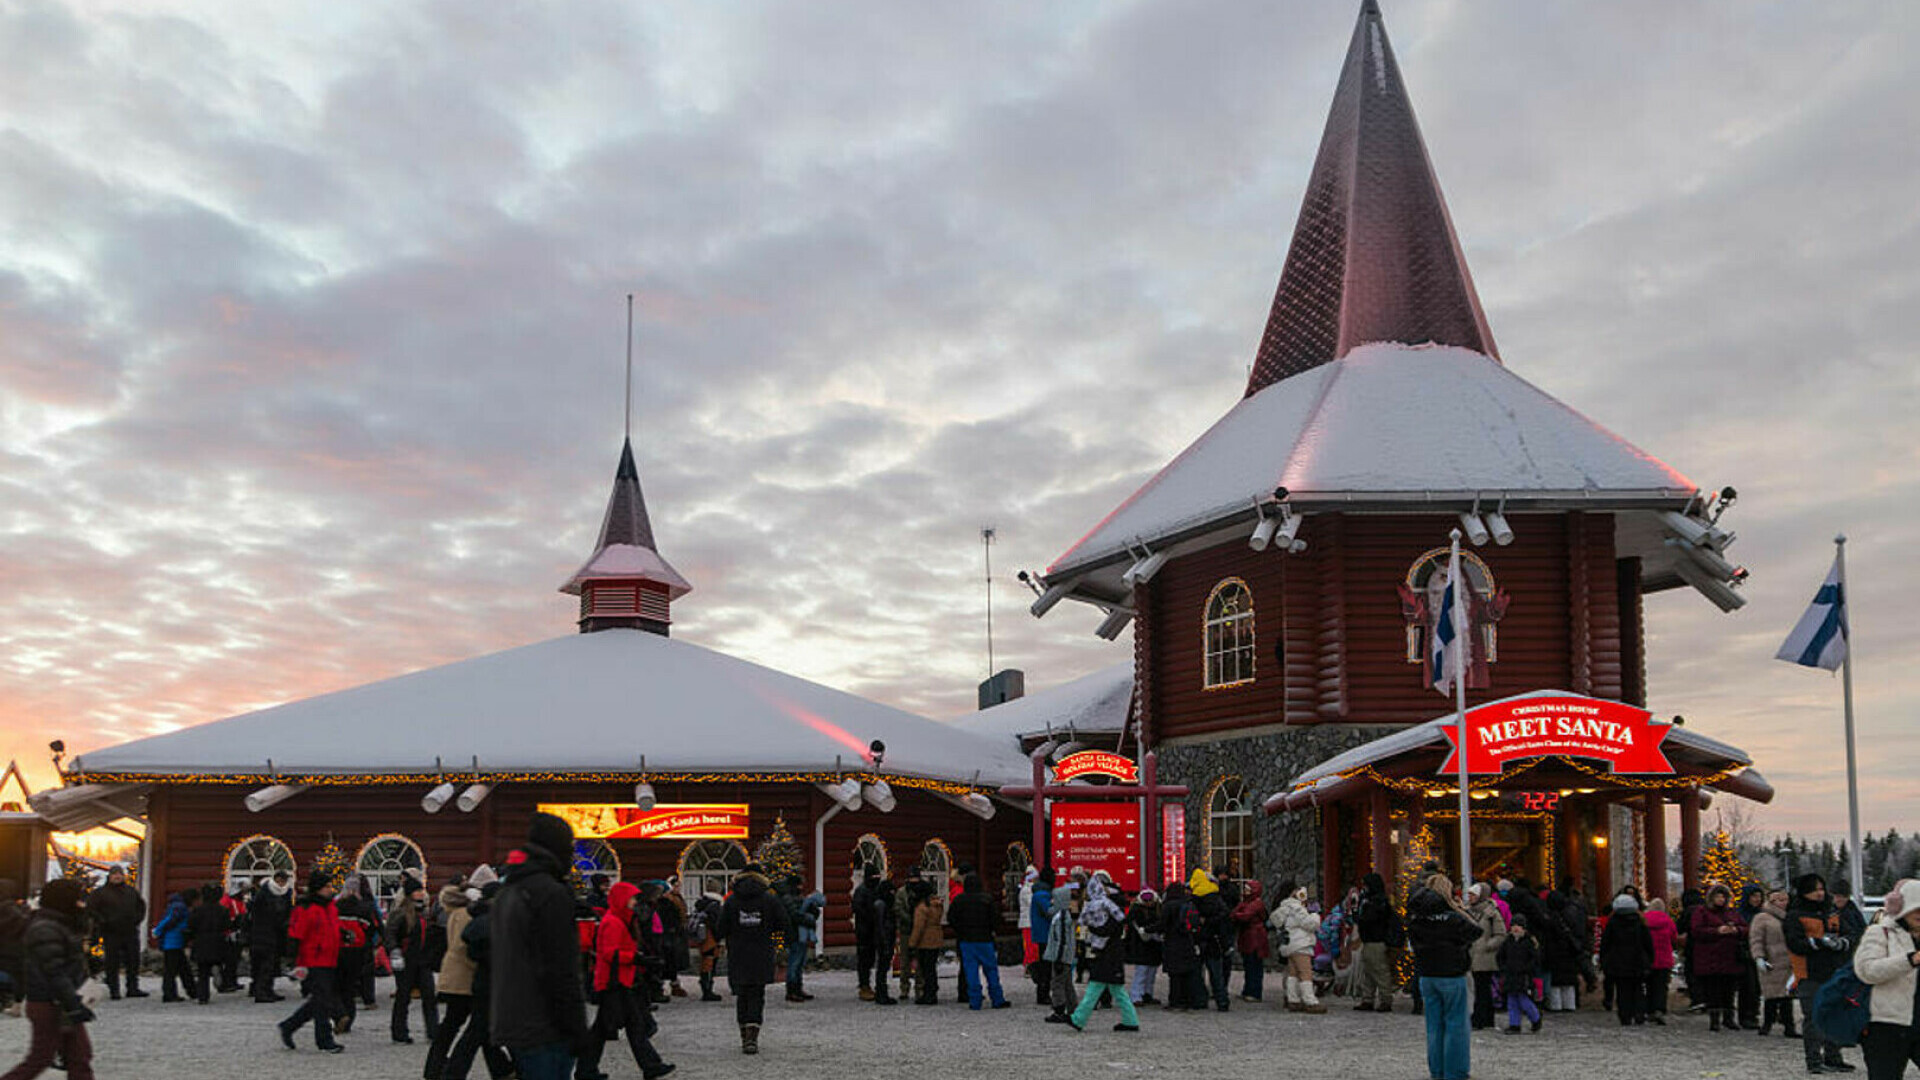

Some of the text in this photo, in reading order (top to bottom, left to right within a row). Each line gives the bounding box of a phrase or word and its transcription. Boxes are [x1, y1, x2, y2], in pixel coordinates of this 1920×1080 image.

[1478, 717, 1633, 746] MEET SANTA
[641, 814, 731, 837] Meet Santa here!
